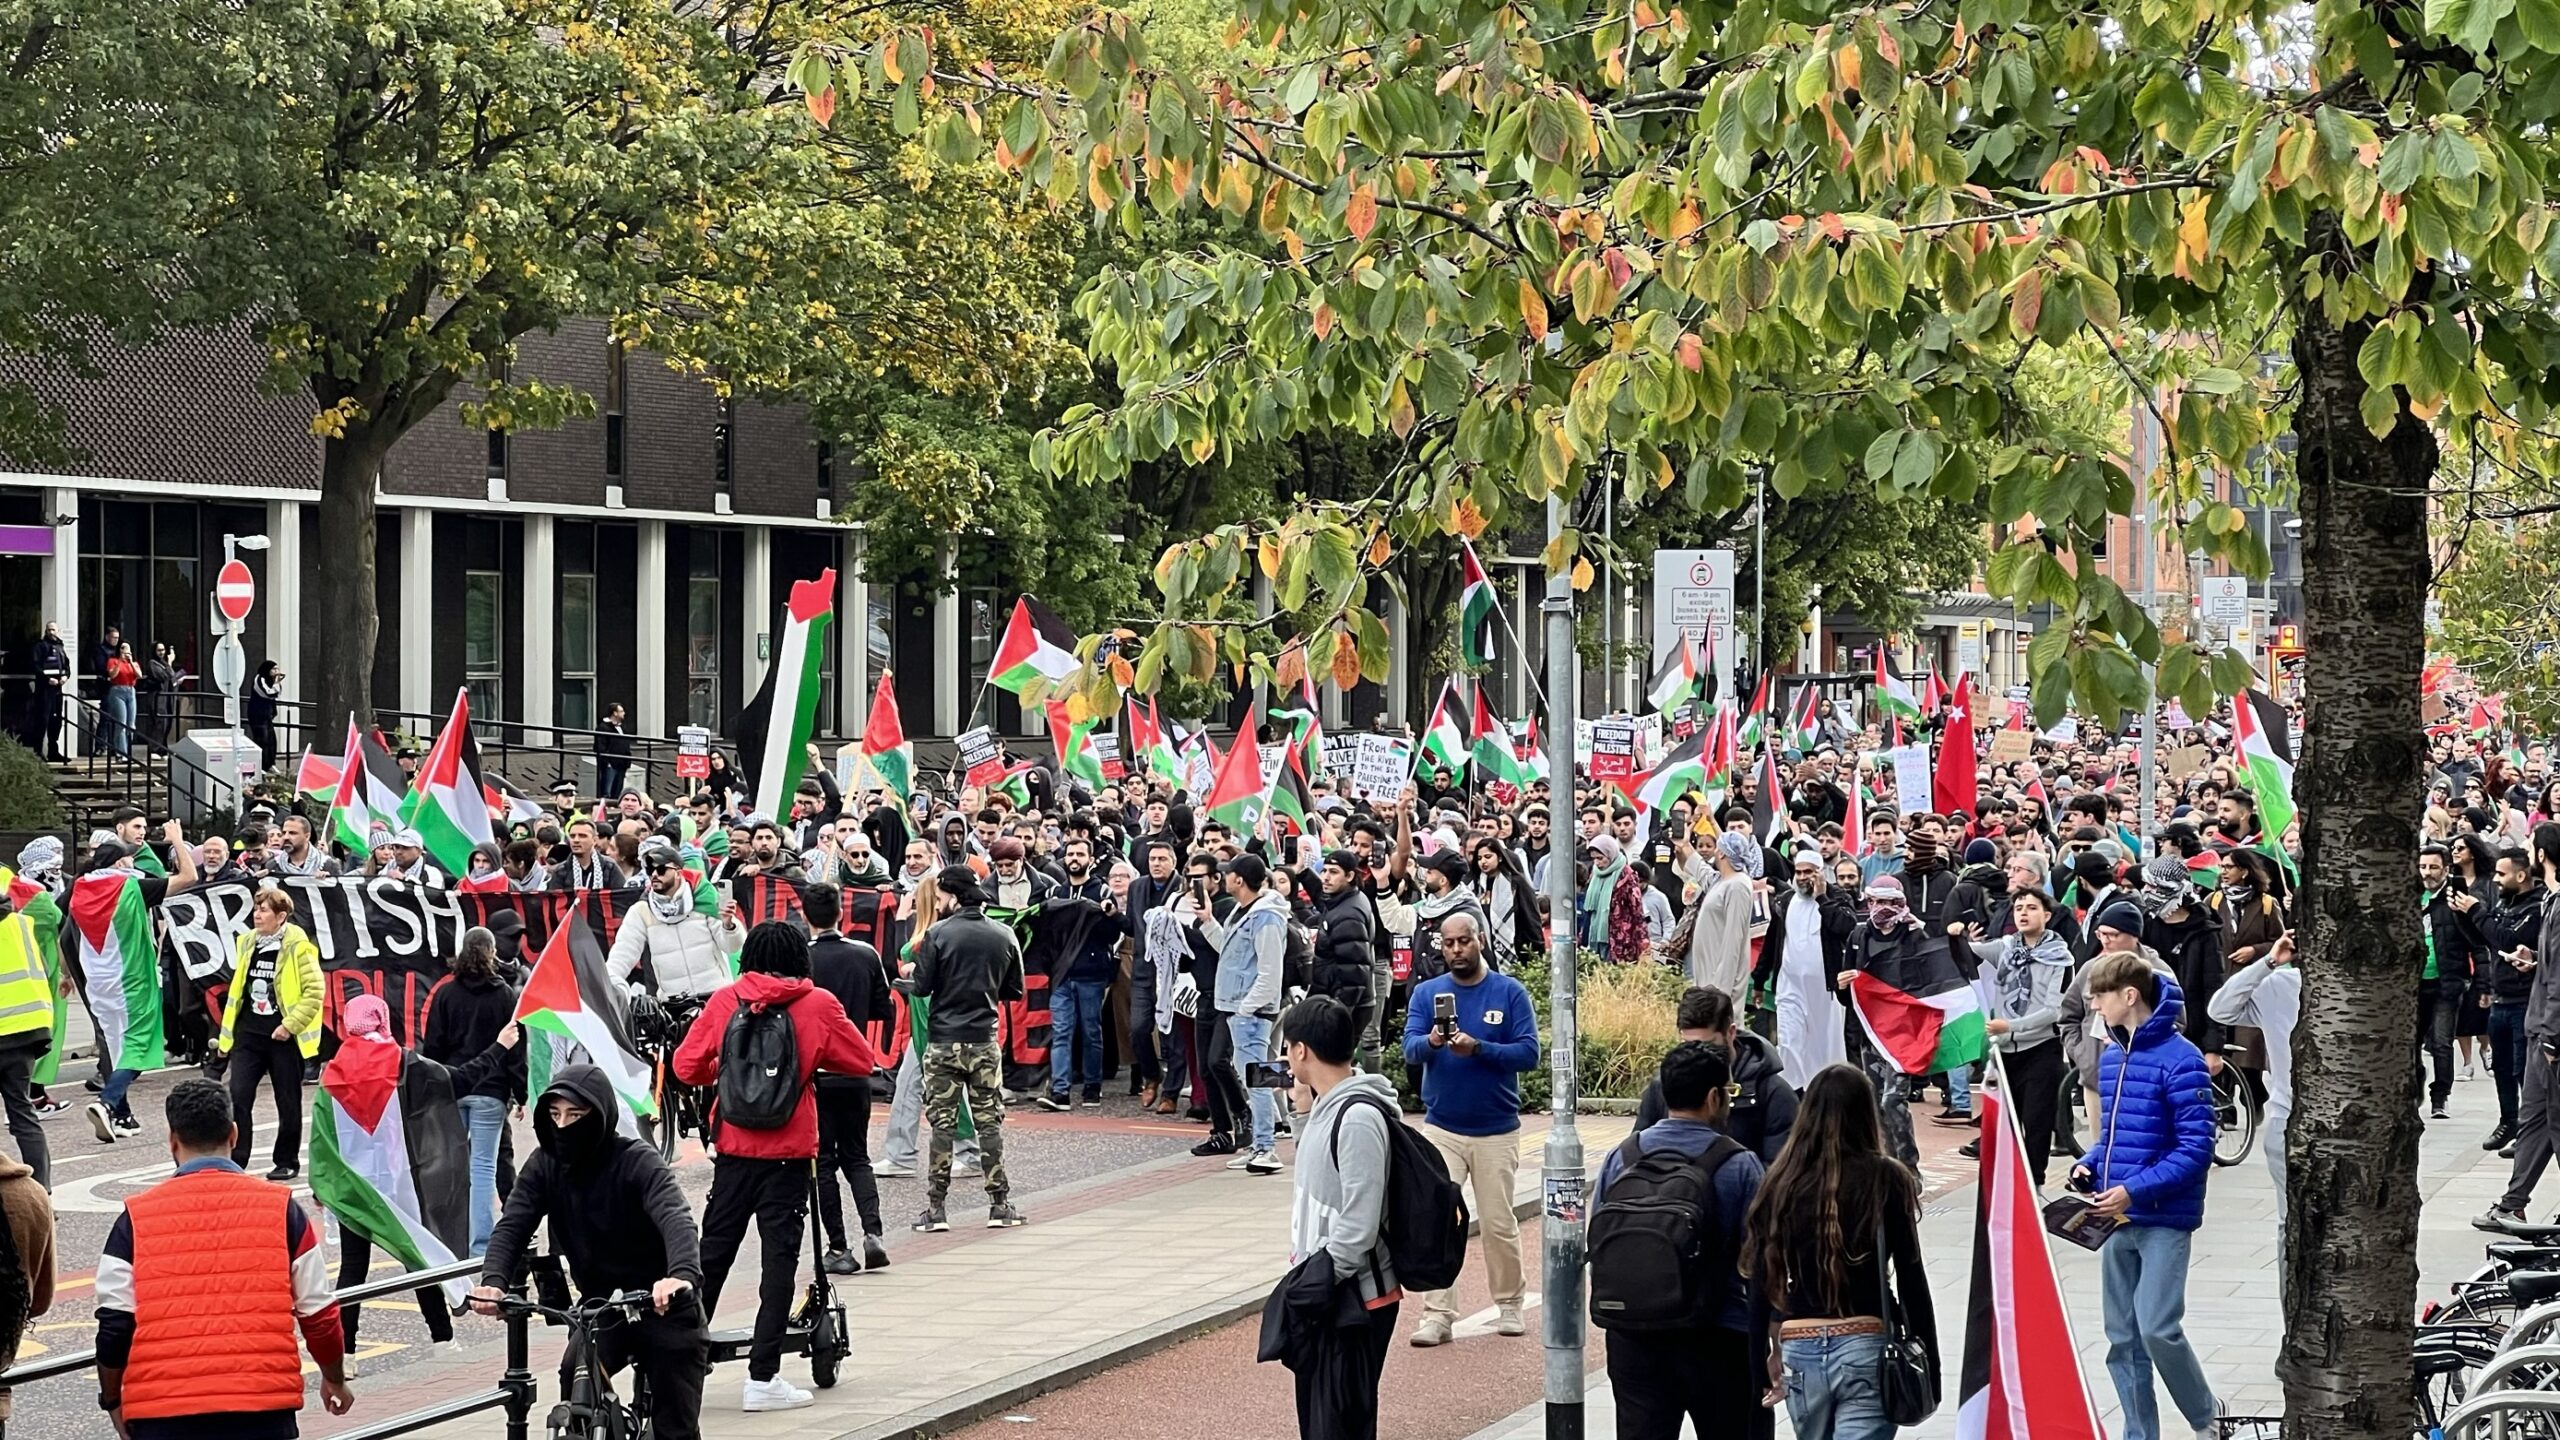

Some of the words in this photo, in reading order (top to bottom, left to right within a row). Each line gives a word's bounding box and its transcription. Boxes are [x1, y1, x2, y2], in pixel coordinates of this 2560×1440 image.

[1596, 728, 1631, 741] FREEDOM
[959, 733, 991, 753] FREEDOM
[1362, 739, 1387, 754] FROM
[1594, 742, 1632, 755] PALESTINE
[963, 745, 998, 769] PALESTINE
[1361, 753, 1375, 763] THE
[1377, 755, 1397, 766] RIVER
[1357, 772, 1392, 784] PALESTINE
[1377, 785, 1397, 800] FREE
[161, 876, 466, 981] BRTISH
